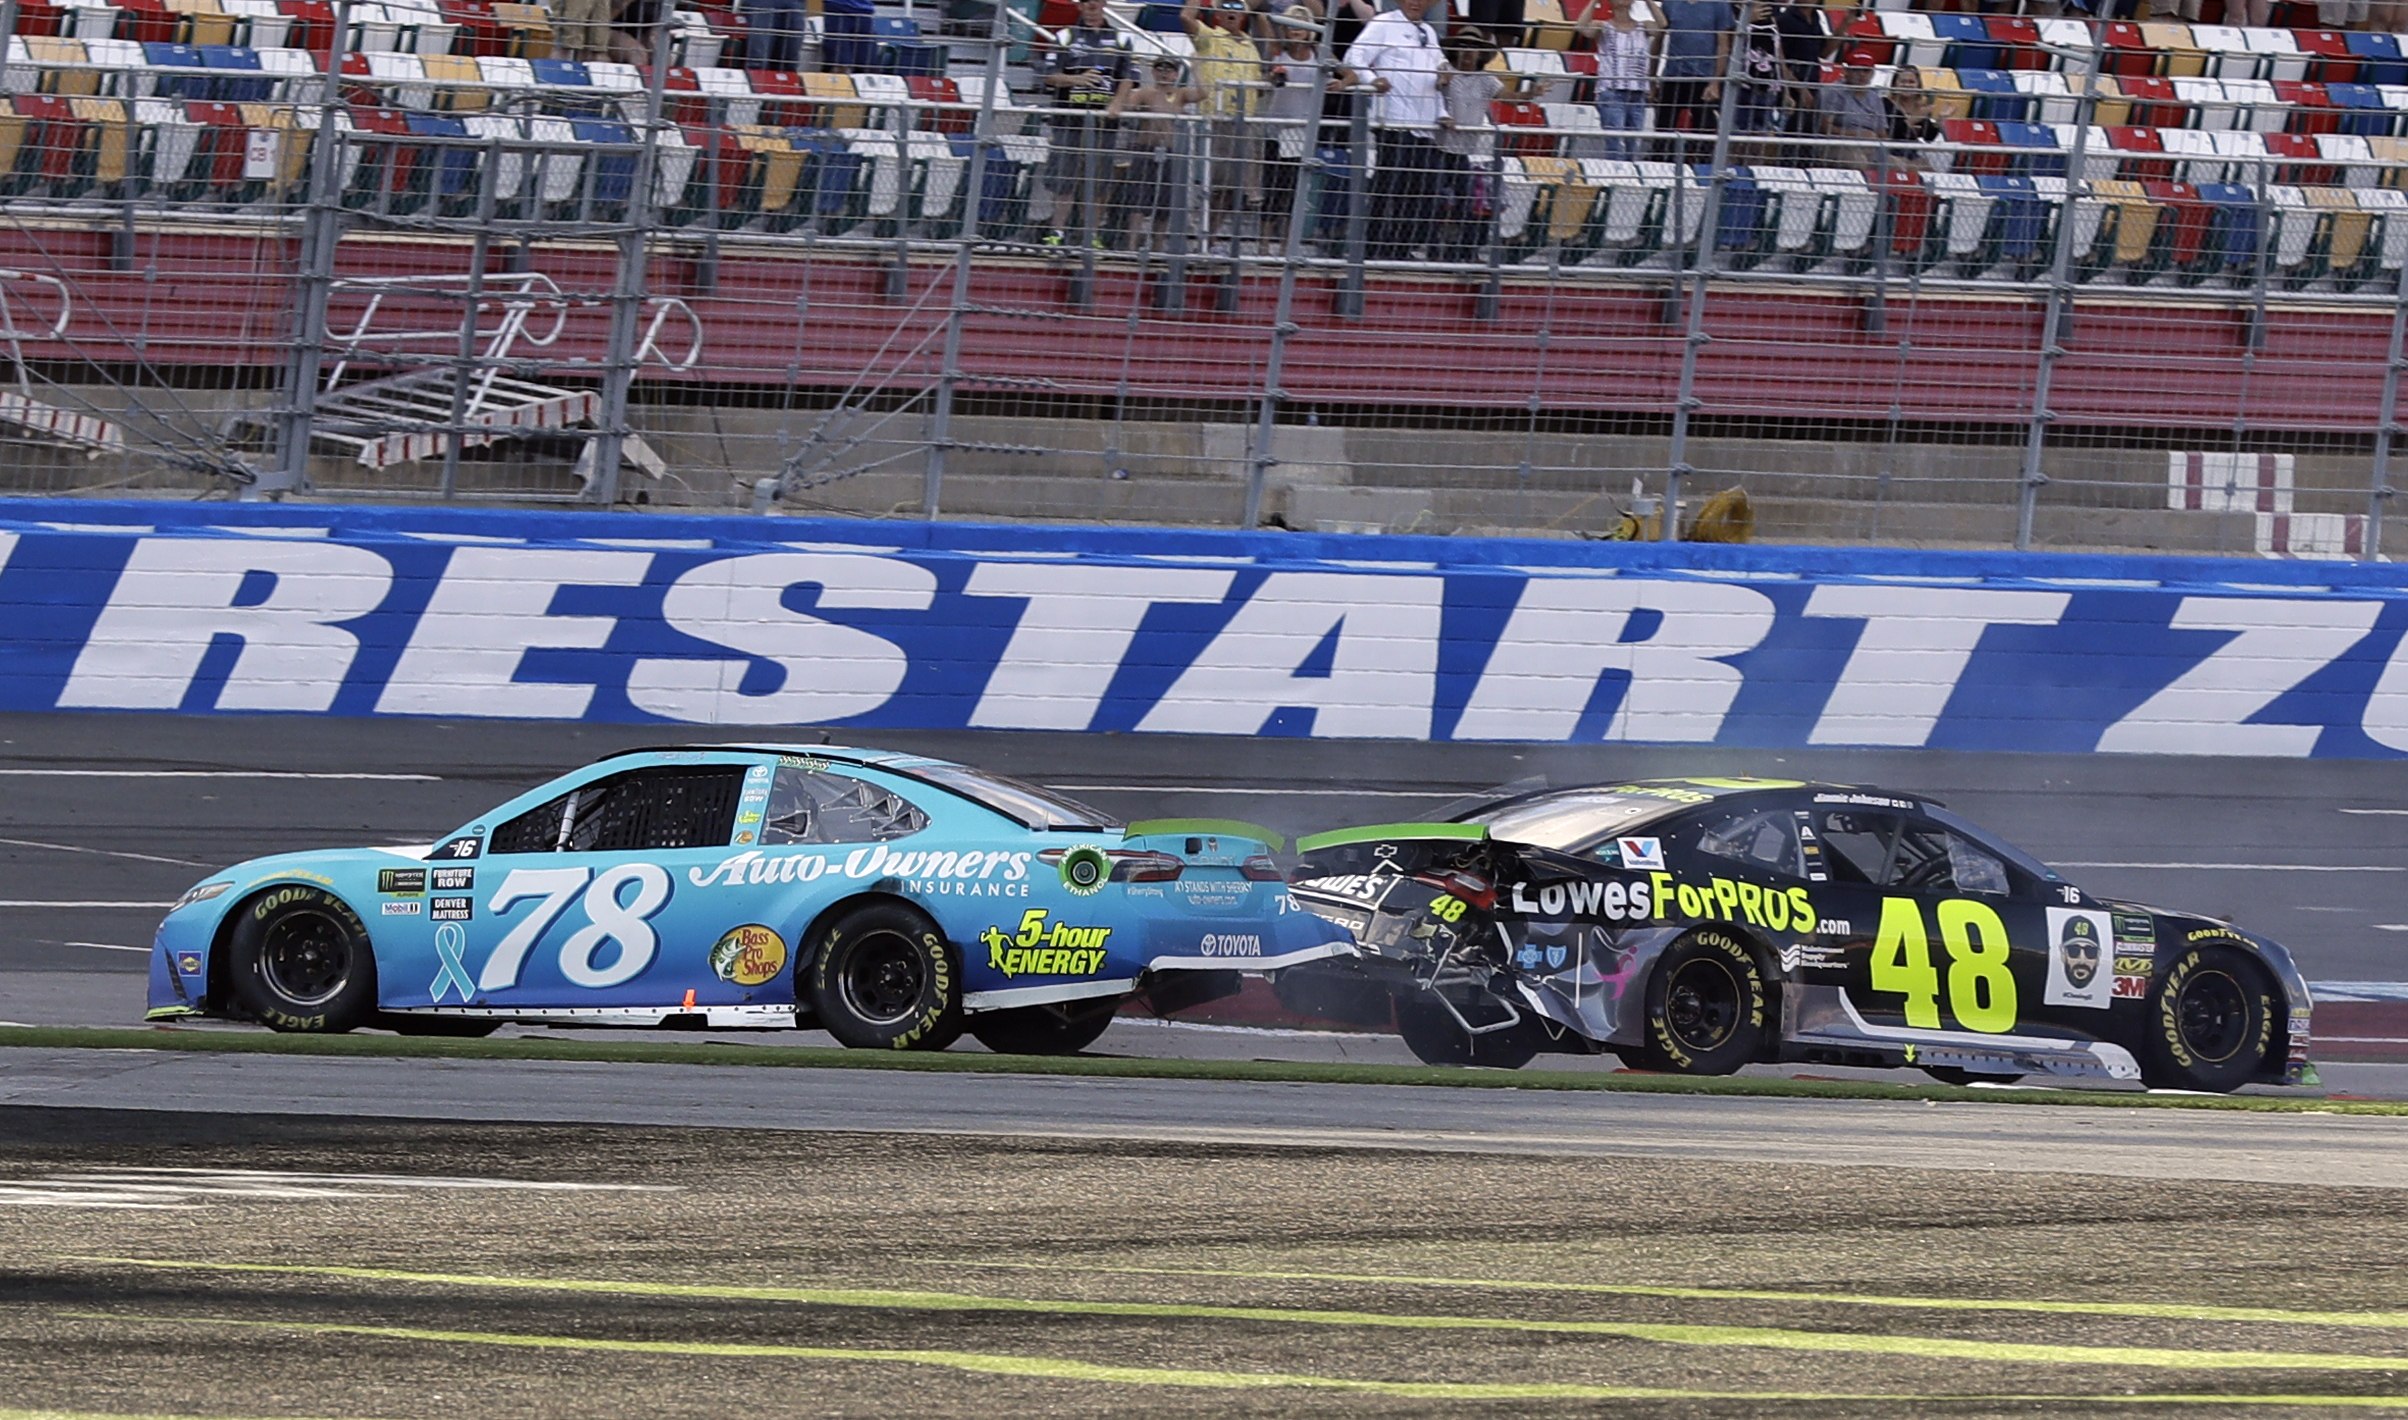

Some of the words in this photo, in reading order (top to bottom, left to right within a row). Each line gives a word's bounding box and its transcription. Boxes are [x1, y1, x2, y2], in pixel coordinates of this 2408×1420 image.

[56, 538, 2072, 746] RESTART
[1061, 843, 1109, 864] AMERICAN
[689, 845, 1032, 888] Auto-Owners
[437, 878, 467, 888] ROW
[900, 880, 1030, 898] INSURANCE
[1062, 876, 1109, 897] ETHANOL
[434, 898, 467, 909] DENVER
[1274, 893, 1302, 915] 78
[1429, 893, 1468, 923] 48
[431, 910, 470, 920] MATTRESS
[477, 862, 676, 993] 78
[741, 929, 770, 945] Bass
[1015, 909, 1113, 948] 5-hour
[2073, 921, 2090, 936] 48
[1217, 934, 1262, 957] TOYOTA
[743, 959, 779, 978] Shops
[1006, 949, 1107, 976] ENERGY
[1869, 896, 2019, 1034] 48
[1696, 931, 1765, 1029] GOODYEAR
[2111, 976, 2145, 998] 3M
[2160, 950, 2202, 1068] GOODYEAR
[1651, 1016, 1693, 1069] EAGLE
